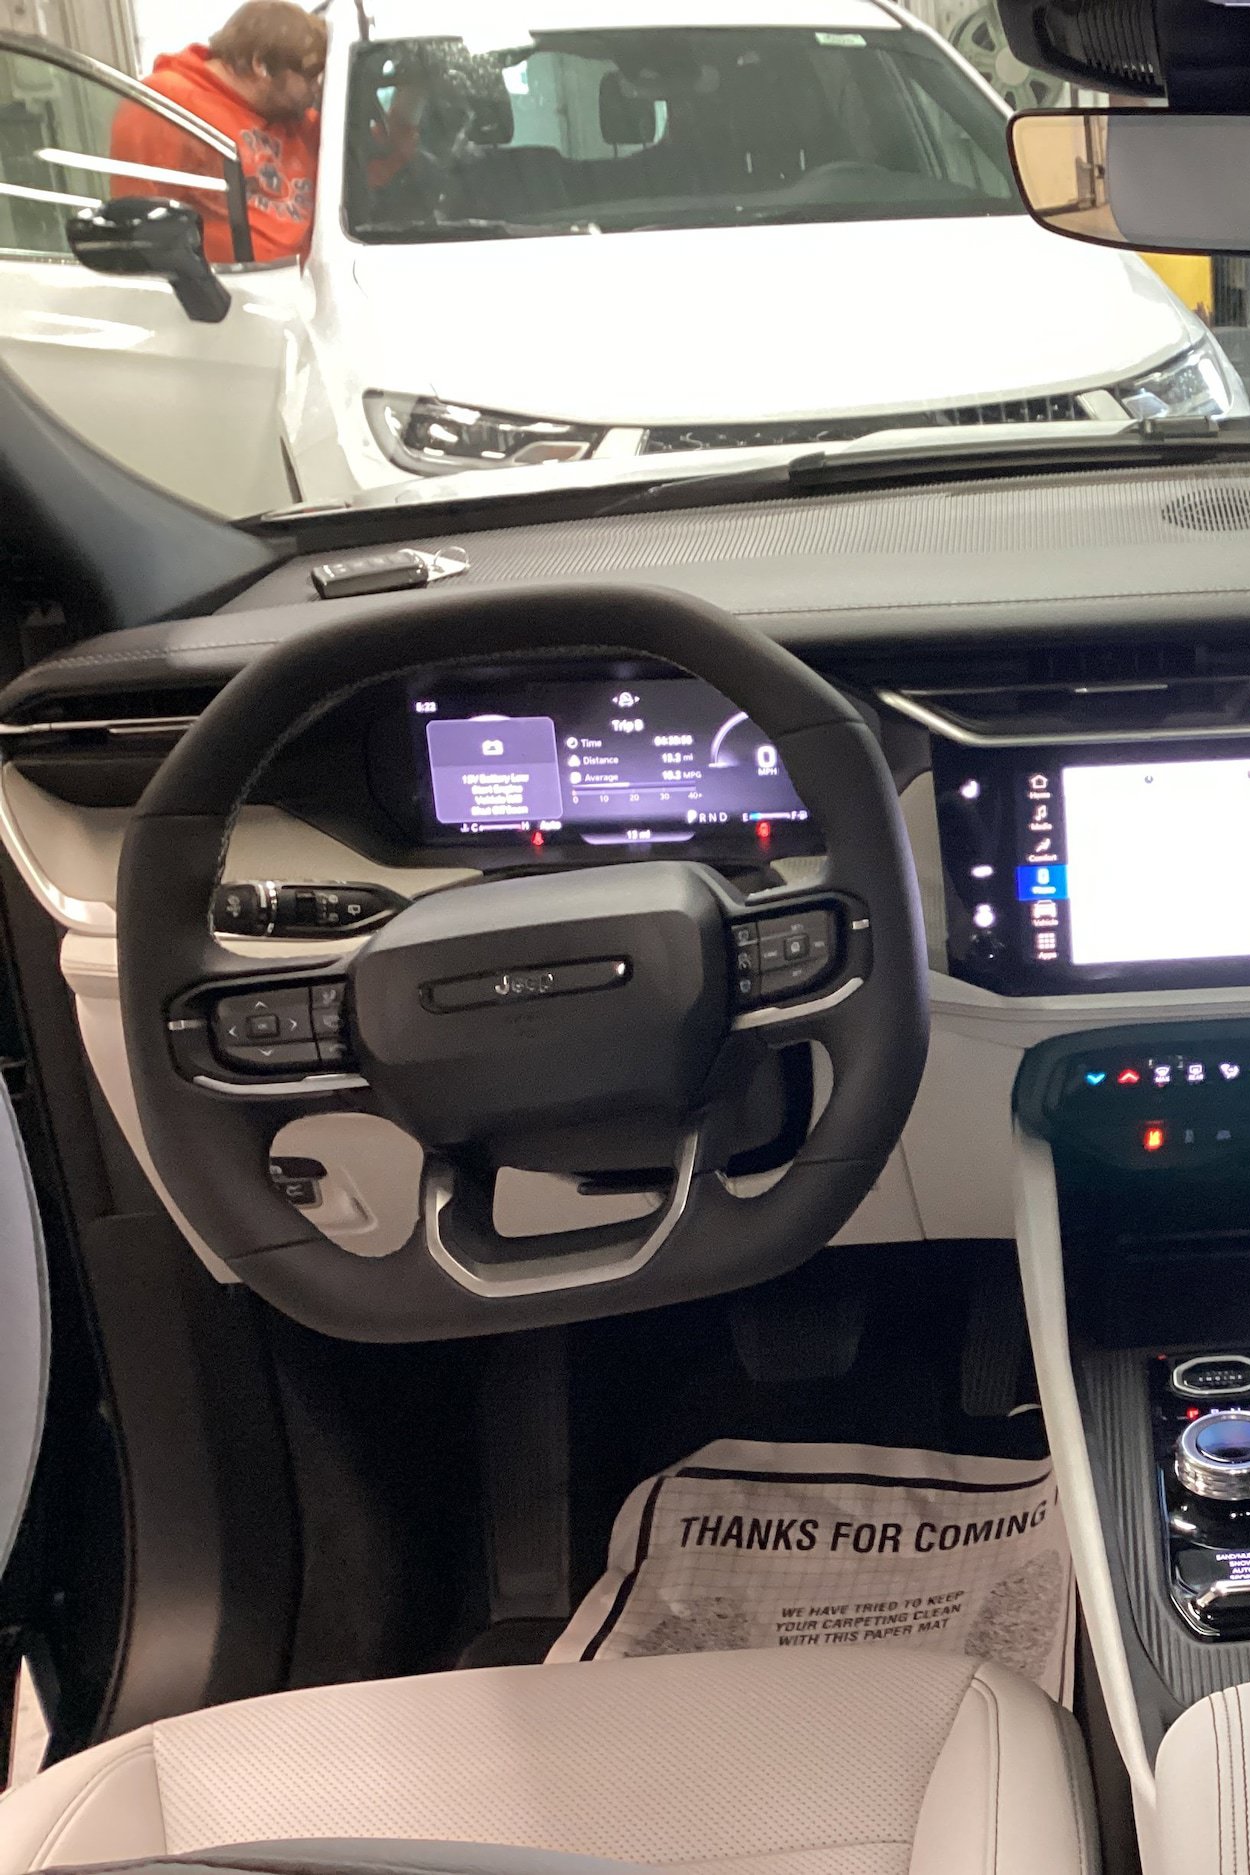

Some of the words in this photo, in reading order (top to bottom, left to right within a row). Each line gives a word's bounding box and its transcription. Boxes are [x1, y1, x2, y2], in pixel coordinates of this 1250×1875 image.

[611, 719, 634, 733] Trip
[580, 739, 602, 748] Time
[583, 756, 619, 765] Distance
[683, 753, 693, 761] mi
[757, 745, 777, 768] 0
[584, 774, 619, 783] Average
[683, 771, 702, 779] MPG
[758, 767, 778, 776] MPH
[699, 814, 706, 822] R
[709, 813, 717, 822] N
[719, 812, 727, 822] D
[494, 972, 554, 995] Jeep
[1199, 1374, 1243, 1383] ENGINE
[680, 1515, 819, 1551] THANKS
[831, 1521, 904, 1554] FOR
[914, 1499, 1047, 1553] COMING
[782, 1607, 806, 1618] WE
[808, 1604, 850, 1617] HAVE
[854, 1601, 898, 1613] TRIED
[904, 1597, 922, 1609] TO
[927, 1590, 965, 1604] KEEP
[776, 1618, 818, 1632] YOUR
[822, 1612, 909, 1630] CARPETING
[913, 1603, 961, 1621] CLEAN
[779, 1634, 820, 1646] WITH
[824, 1630, 859, 1644] THIS
[863, 1624, 912, 1641] PAPER
[917, 1618, 950, 1633] MAT
